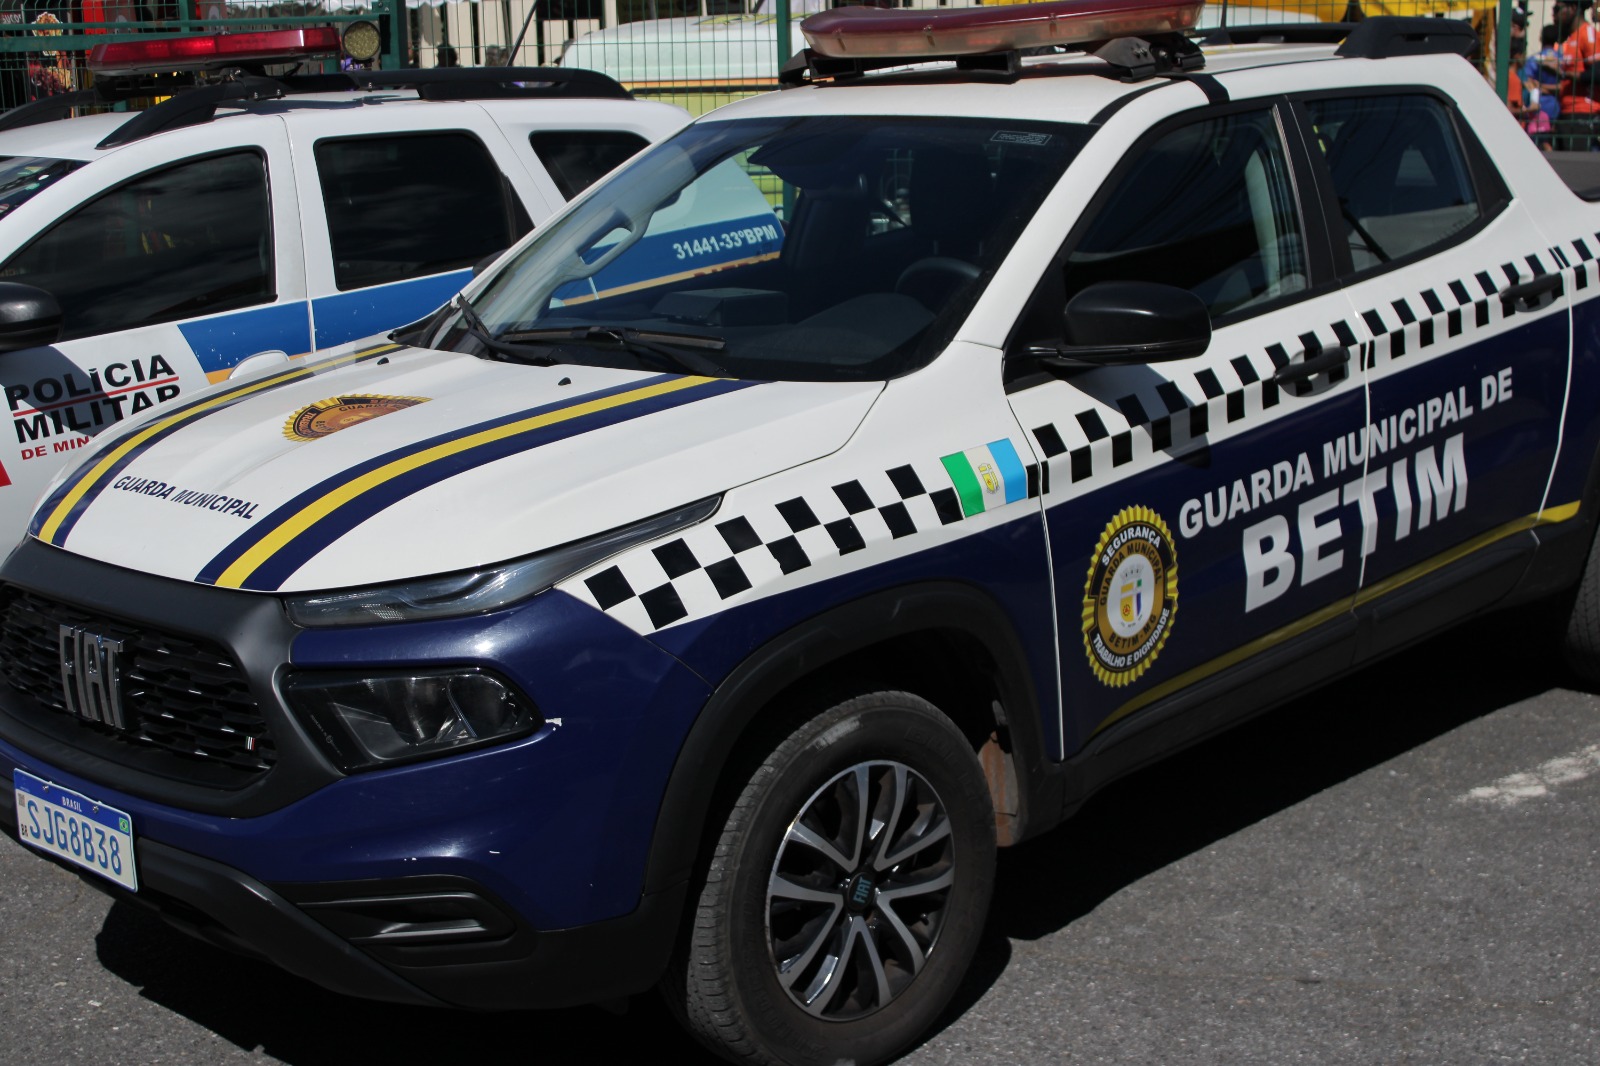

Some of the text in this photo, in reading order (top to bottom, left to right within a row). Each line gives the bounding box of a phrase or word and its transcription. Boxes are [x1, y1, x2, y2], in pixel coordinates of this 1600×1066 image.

[20, 433, 99, 461] DE MIN
[1178, 366, 1513, 539] GUARDA MUNICIPAL DE
[113, 475, 260, 520] GUARDA MUNICIPAL
[1242, 432, 1468, 614] BETIM
[1100, 541, 1162, 607] GUARDA MUNICIPAL
[1101, 525, 1161, 567] SEGURANÇA
[1092, 632, 1126, 668] TRABALHO
[1126, 654, 1133, 666] E
[1133, 607, 1170, 662] DIGNIDADE
[59, 623, 125, 730] FIAT
[61, 795, 83, 813] BRASIL
[27, 799, 123, 876] SJG8B38
[853, 876, 872, 904] FIAT
